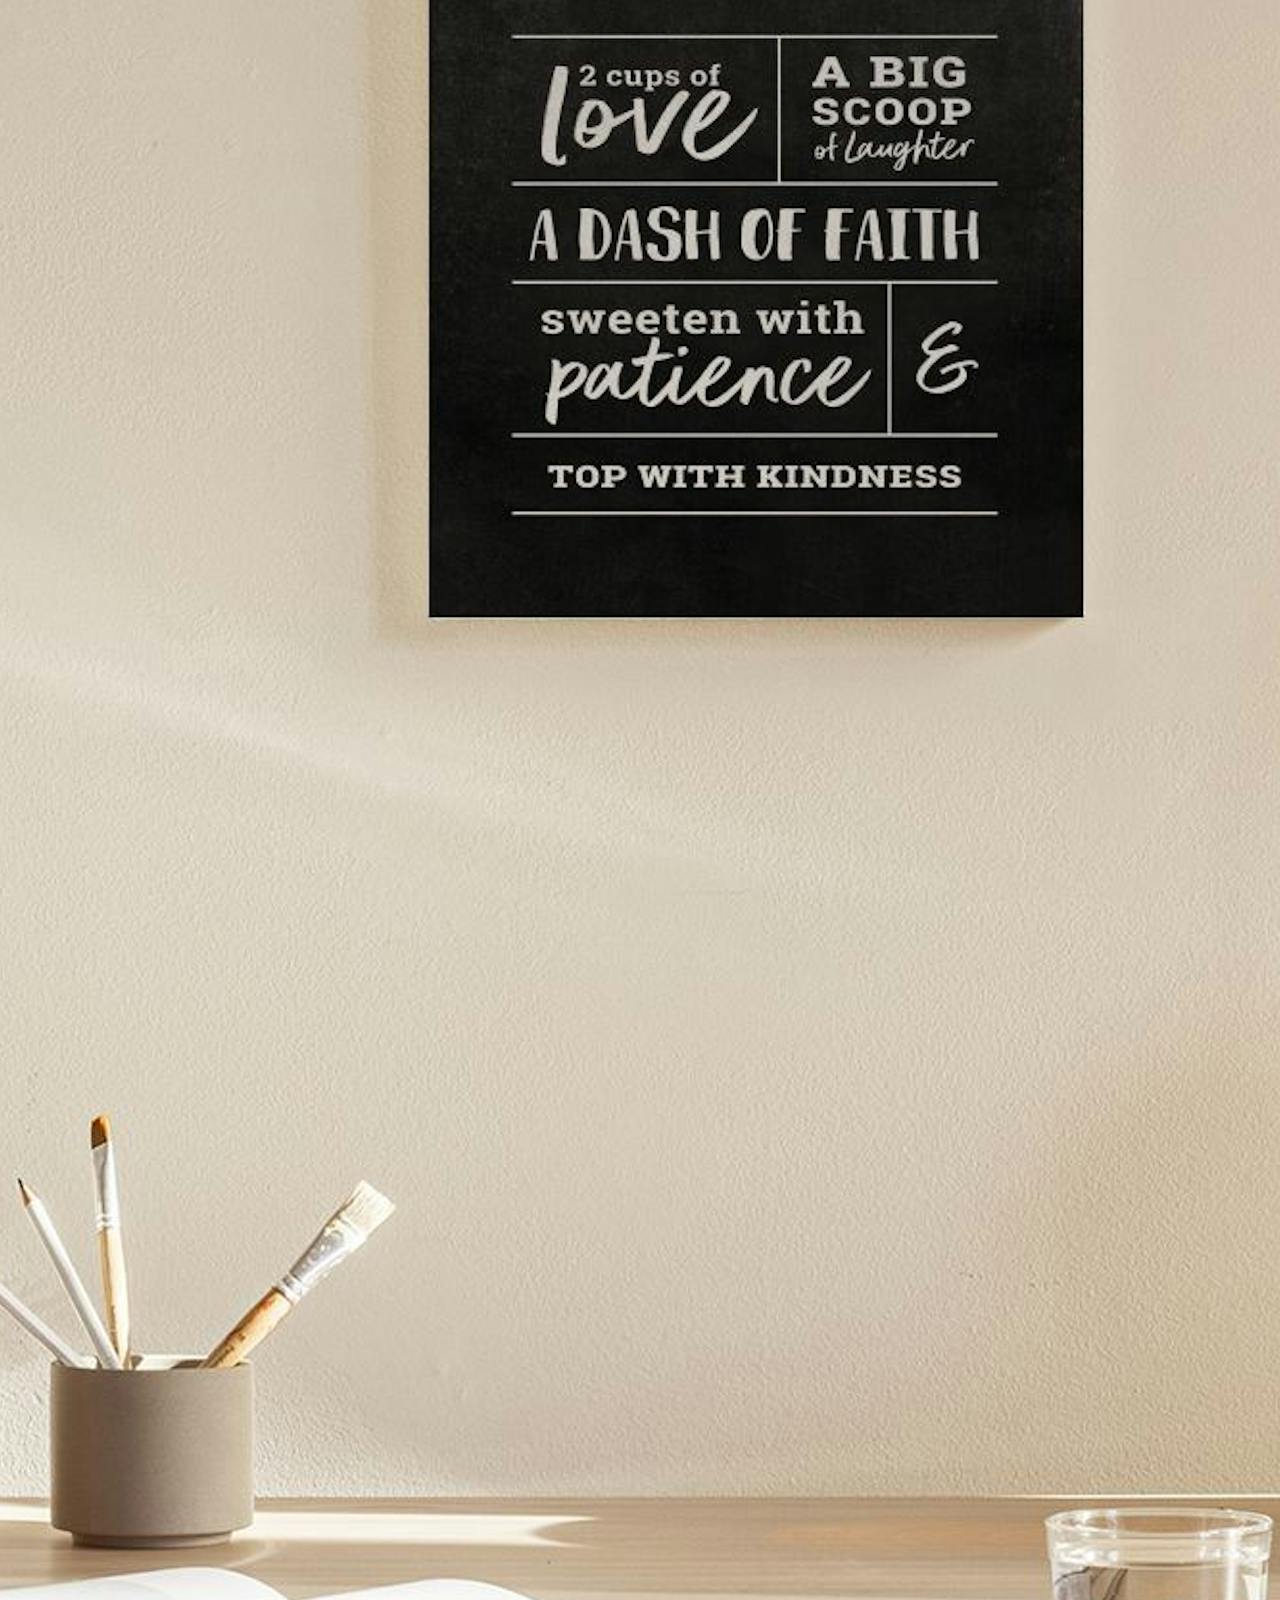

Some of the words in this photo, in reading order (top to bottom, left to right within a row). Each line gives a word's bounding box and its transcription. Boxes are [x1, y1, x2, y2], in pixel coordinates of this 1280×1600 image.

[579, 64, 597, 87] 2
[606, 68, 681, 93] cups
[689, 63, 722, 87] of
[811, 55, 851, 89] A
[869, 55, 966, 89] BIG
[540, 64, 759, 167] love
[811, 97, 972, 126] SCOOP
[813, 131, 839, 162] of
[529, 208, 559, 262] A
[578, 205, 721, 262] DASH
[740, 207, 806, 262] OF
[824, 207, 980, 262] FAITH
[541, 304, 741, 335] sweeten
[755, 299, 865, 335] with
[915, 320, 979, 395] &
[544, 336, 872, 426] patience
[547, 464, 628, 489] TOP
[637, 464, 746, 489] WITH
[756, 464, 962, 489] KINDNESS
